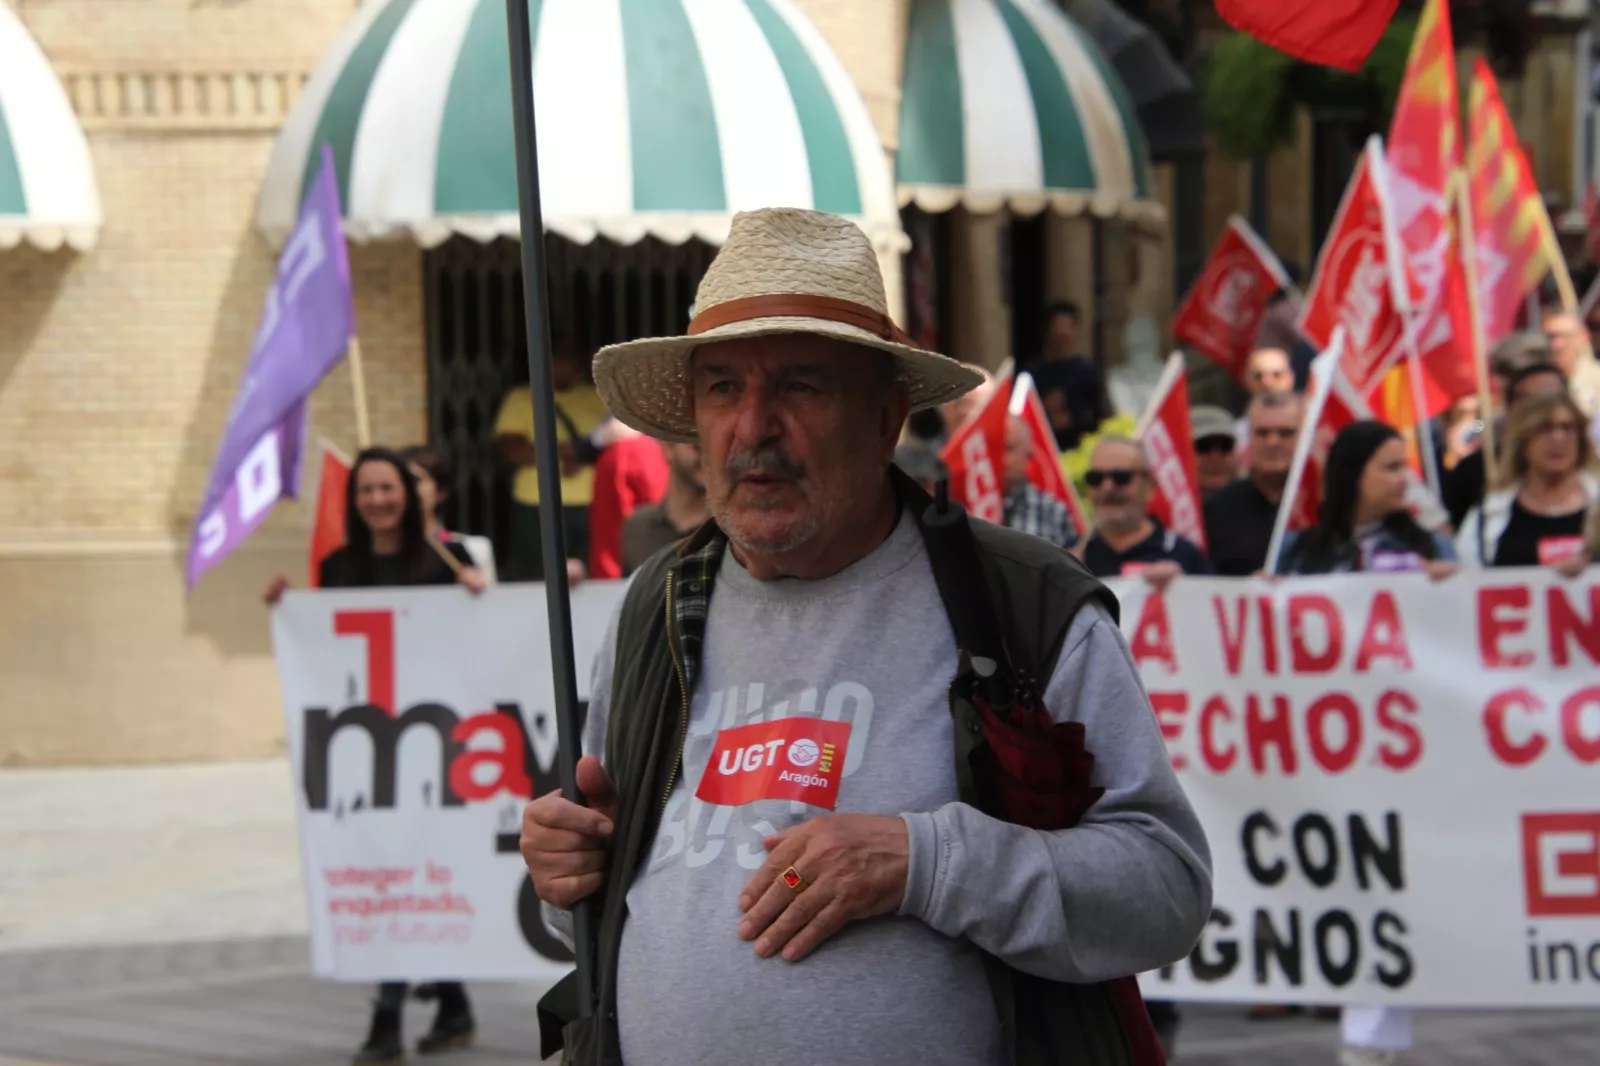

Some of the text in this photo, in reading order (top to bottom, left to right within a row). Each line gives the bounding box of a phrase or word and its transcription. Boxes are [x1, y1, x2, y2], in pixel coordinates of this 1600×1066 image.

[1212, 589, 1415, 677] VIDA
[718, 738, 786, 776] UGT
[778, 770, 829, 788] Aragón
[1240, 809, 1405, 892] CON
[1159, 906, 1414, 991] GNOS
